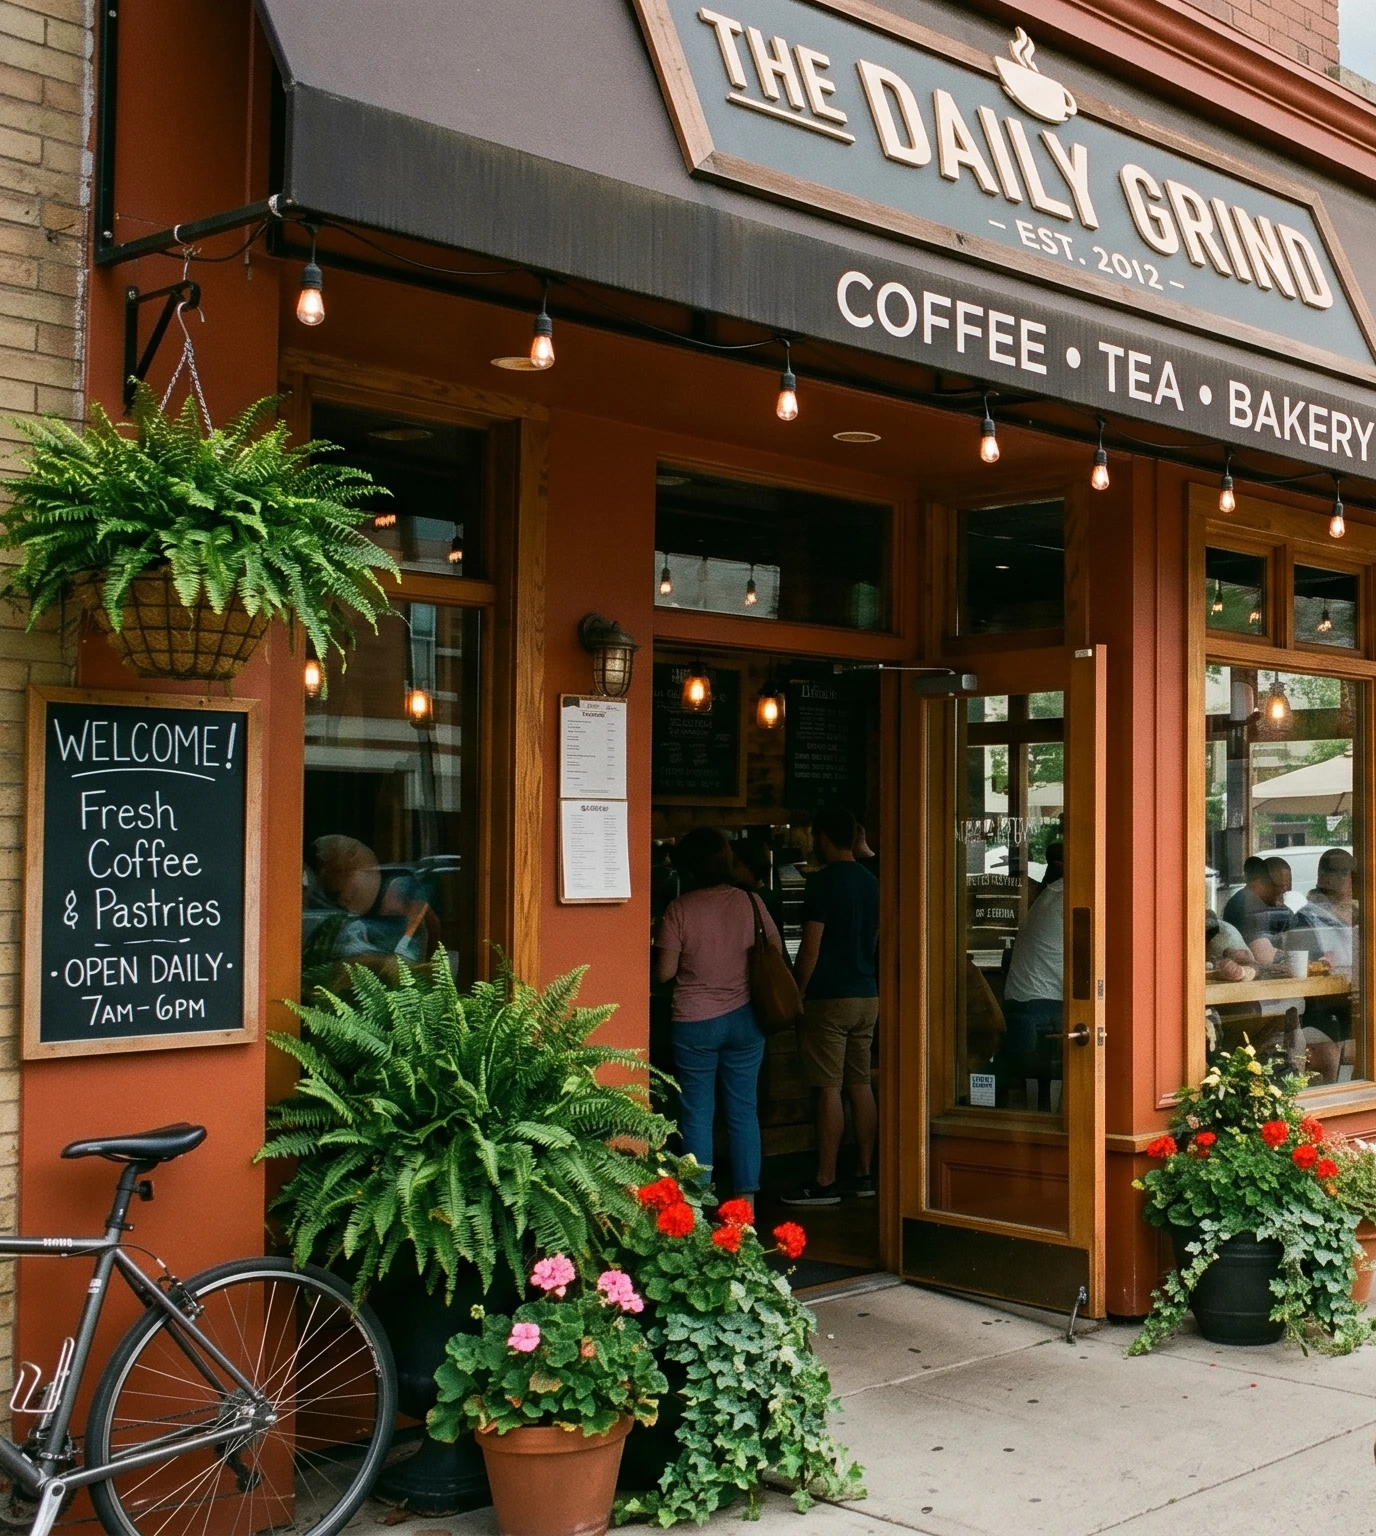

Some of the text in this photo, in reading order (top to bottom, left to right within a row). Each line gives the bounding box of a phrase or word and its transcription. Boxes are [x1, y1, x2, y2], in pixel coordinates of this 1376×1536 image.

[699, 7, 1335, 311] THE DAILY GRIND
[1015, 219, 1163, 291] EST. 2012
[836, 270, 1375, 462] COFFEE TEA BAKERY
[53, 718, 237, 770] WELCOME!
[81, 789, 178, 831] Fresh
[88, 838, 203, 879] Coffee
[63, 887, 222, 930] & Pastries
[64, 952, 224, 988] OPEN DAILY
